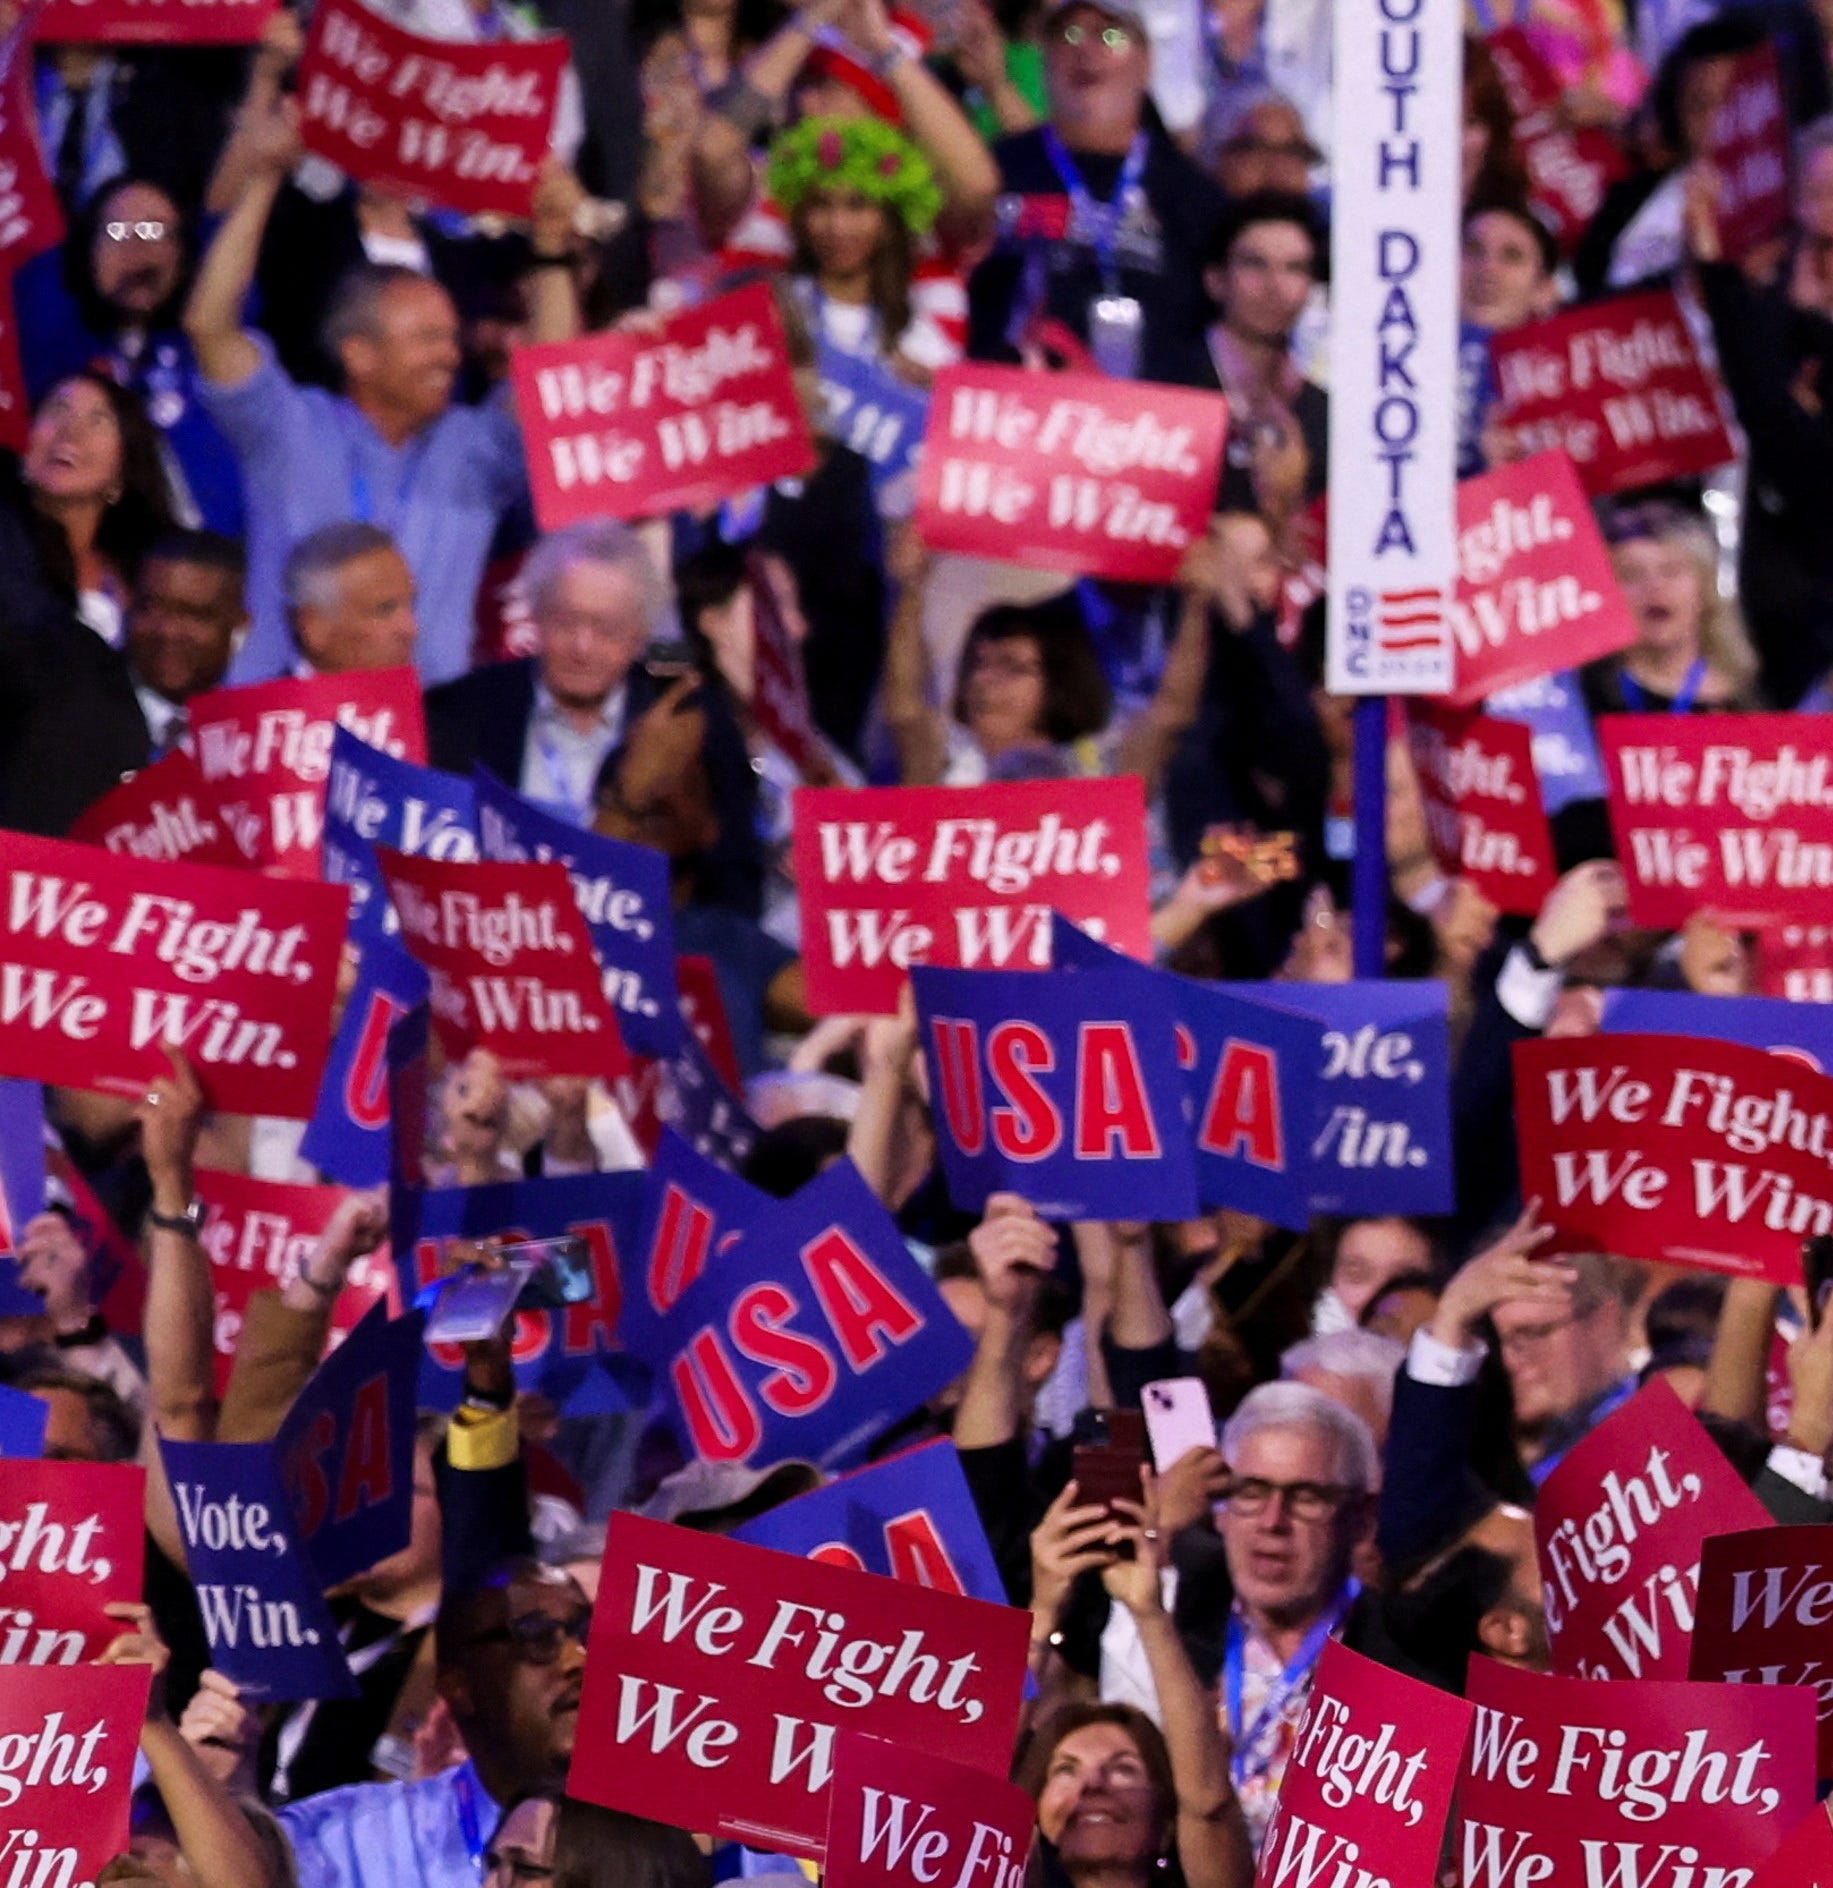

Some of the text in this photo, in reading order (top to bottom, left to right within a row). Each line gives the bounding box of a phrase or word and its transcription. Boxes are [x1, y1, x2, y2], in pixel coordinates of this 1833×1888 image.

[1374, 0, 1425, 556] UTH DAKOTA
[933, 1018, 1162, 1163] USA
[1547, 1067, 1651, 1123] We
[1554, 1151, 1667, 1209] We
[672, 1226, 924, 1463] USA
[175, 1483, 286, 1554] Vote,
[196, 1584, 319, 1647] Win.
[632, 1564, 983, 1723] We Fight,
[617, 1675, 738, 1767] We
[1309, 1695, 1428, 1827] Fight,
[1472, 1705, 1779, 1821] We Fight,
